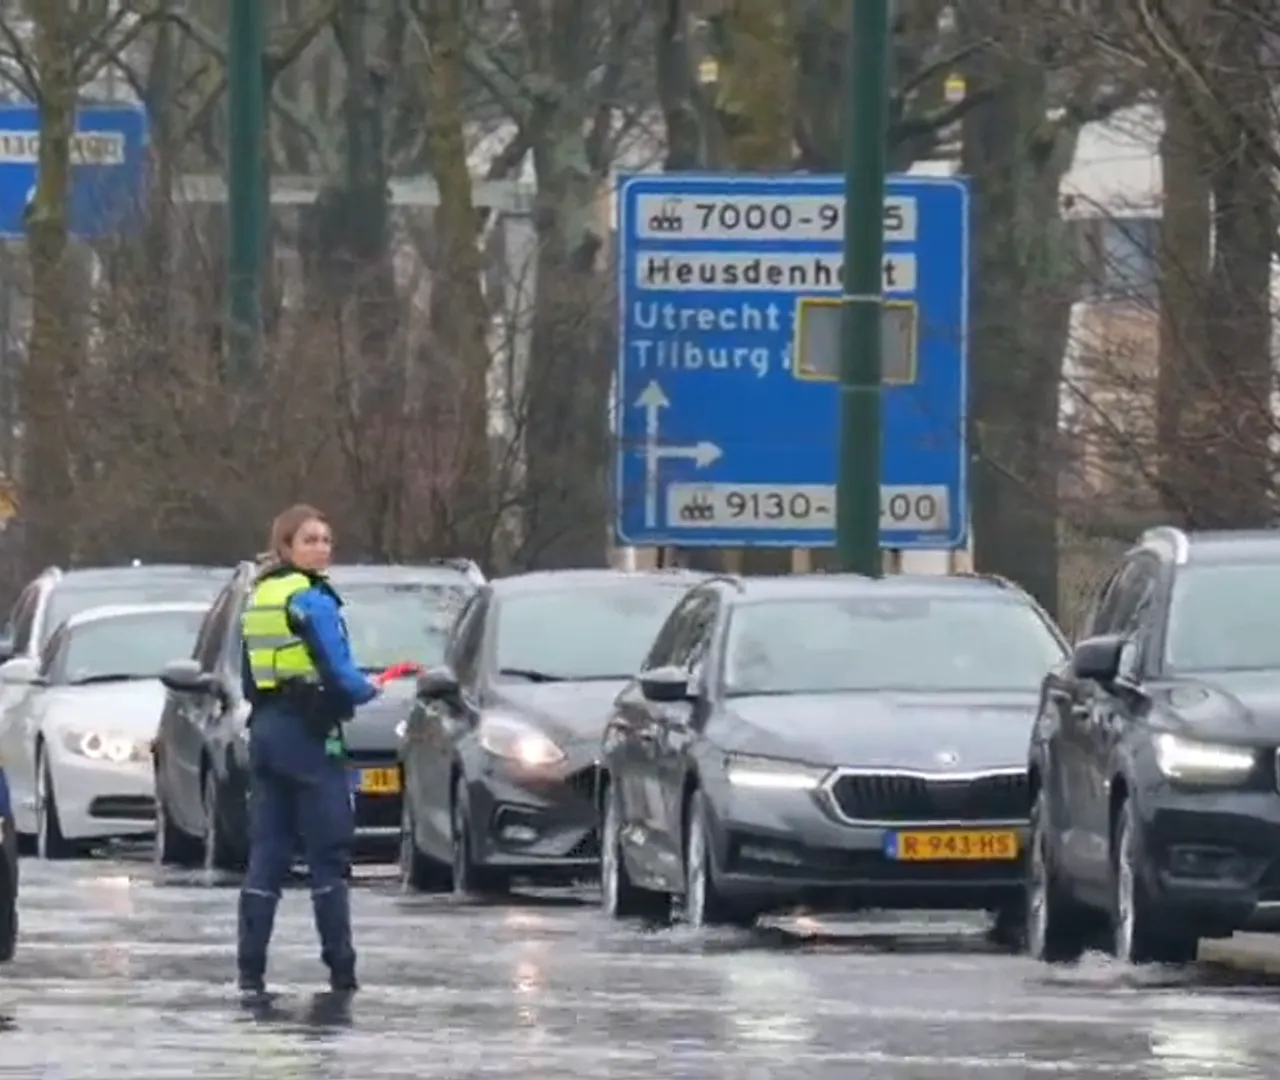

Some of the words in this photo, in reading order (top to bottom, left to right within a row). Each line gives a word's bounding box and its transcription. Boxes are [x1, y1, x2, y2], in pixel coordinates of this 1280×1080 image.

[695, 203, 904, 231] 7000-95
[647, 258, 897, 286] Heusdenht
[633, 301, 780, 331] Utrecht
[631, 340, 770, 378] Tilburg
[726, 491, 937, 521] 9130-00
